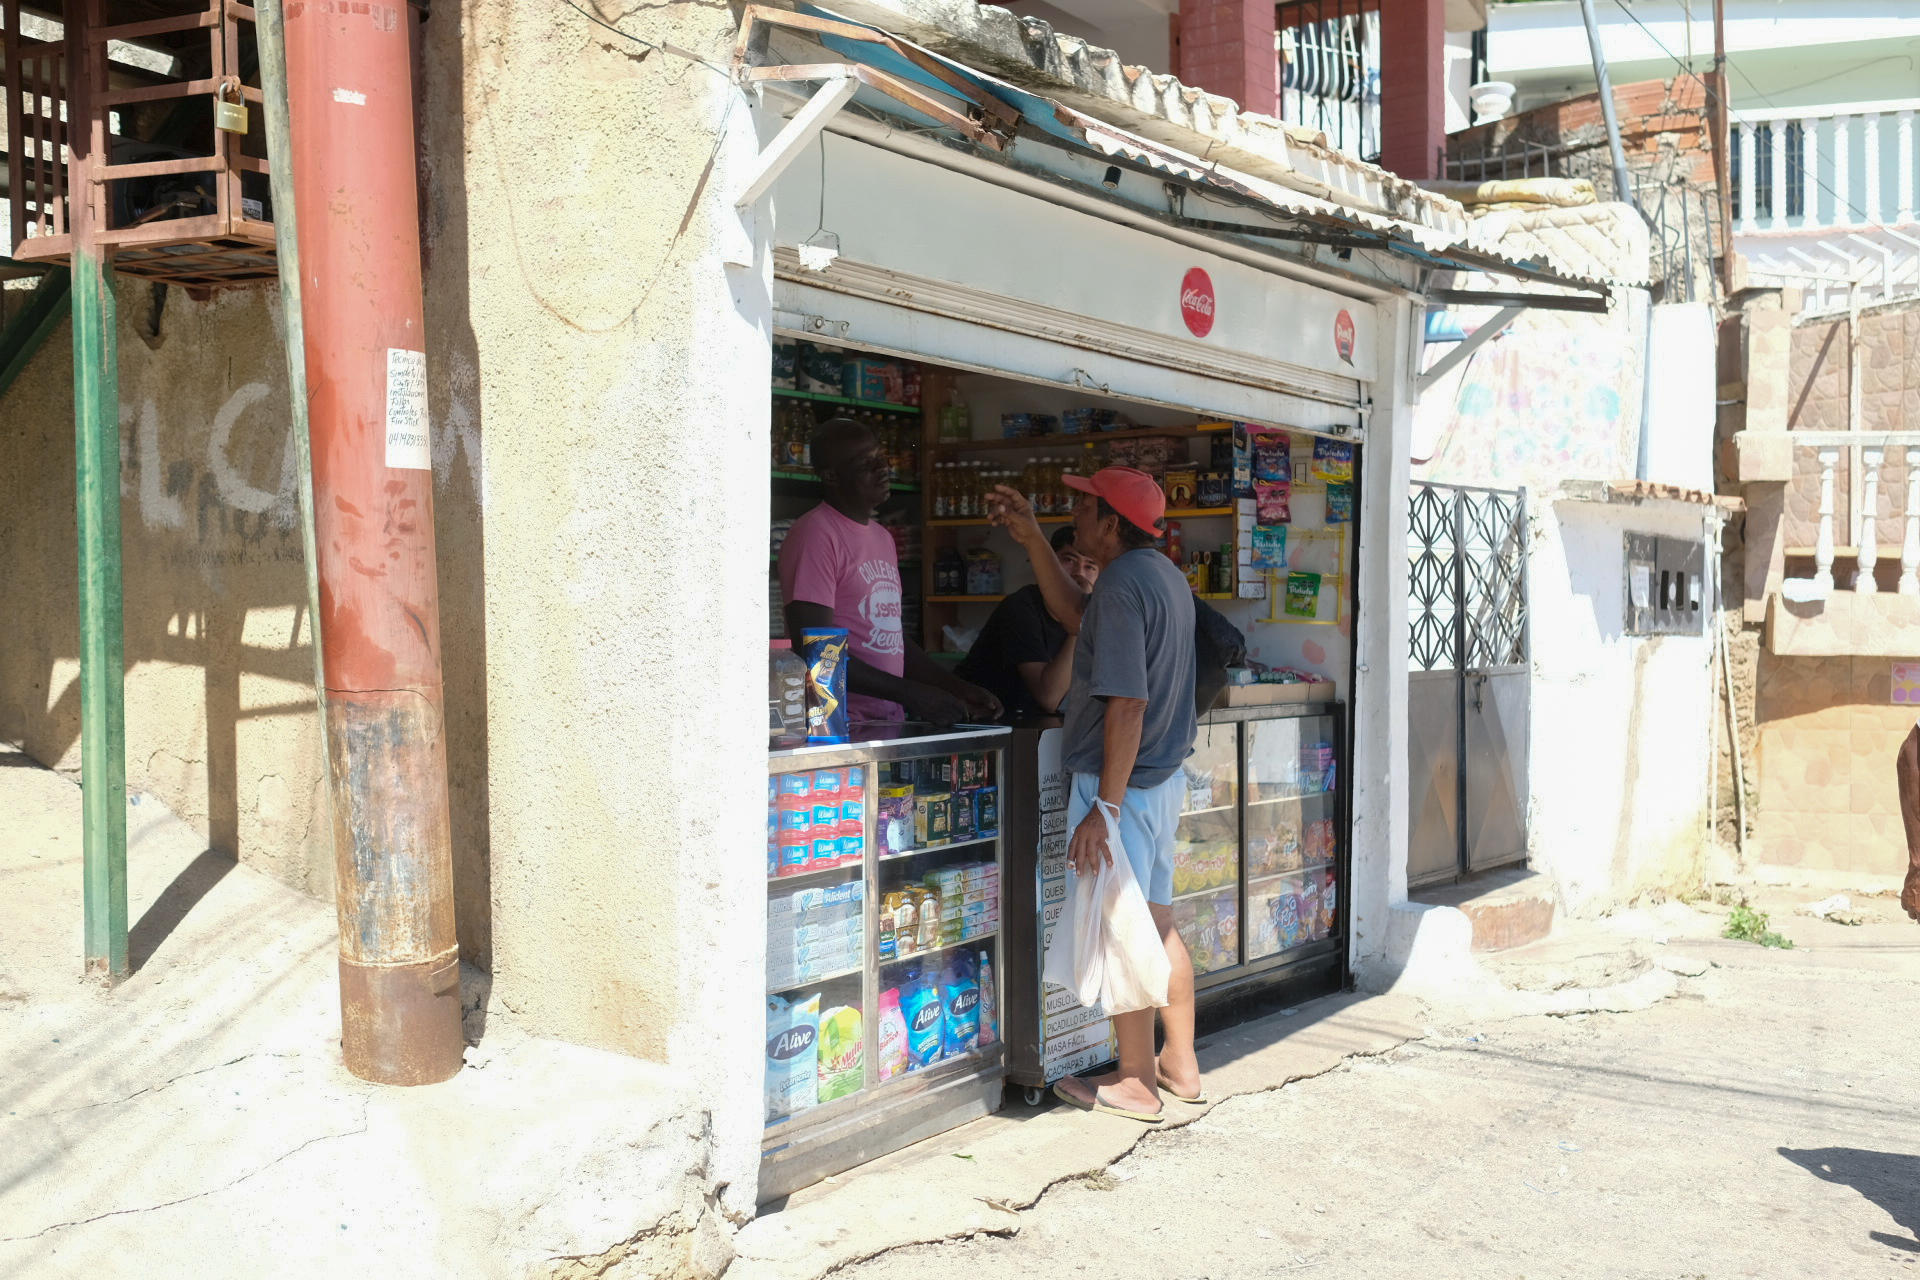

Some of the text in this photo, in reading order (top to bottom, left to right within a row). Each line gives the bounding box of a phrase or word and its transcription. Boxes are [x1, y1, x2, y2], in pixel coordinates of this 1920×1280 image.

[859, 559, 899, 584] COLLEGE
[1044, 907, 1063, 921] QUE
[953, 993, 978, 1013] Alive
[1046, 994, 1071, 1011] MUSLO
[914, 1005, 940, 1030] Alive
[1047, 1014, 1078, 1034] PICADILLO
[1079, 1011, 1088, 1023] DE
[774, 1031, 812, 1057] Alive
[1047, 1031, 1087, 1055] MASA FÁCIL
[1046, 1056, 1084, 1078] CACHAPAS
